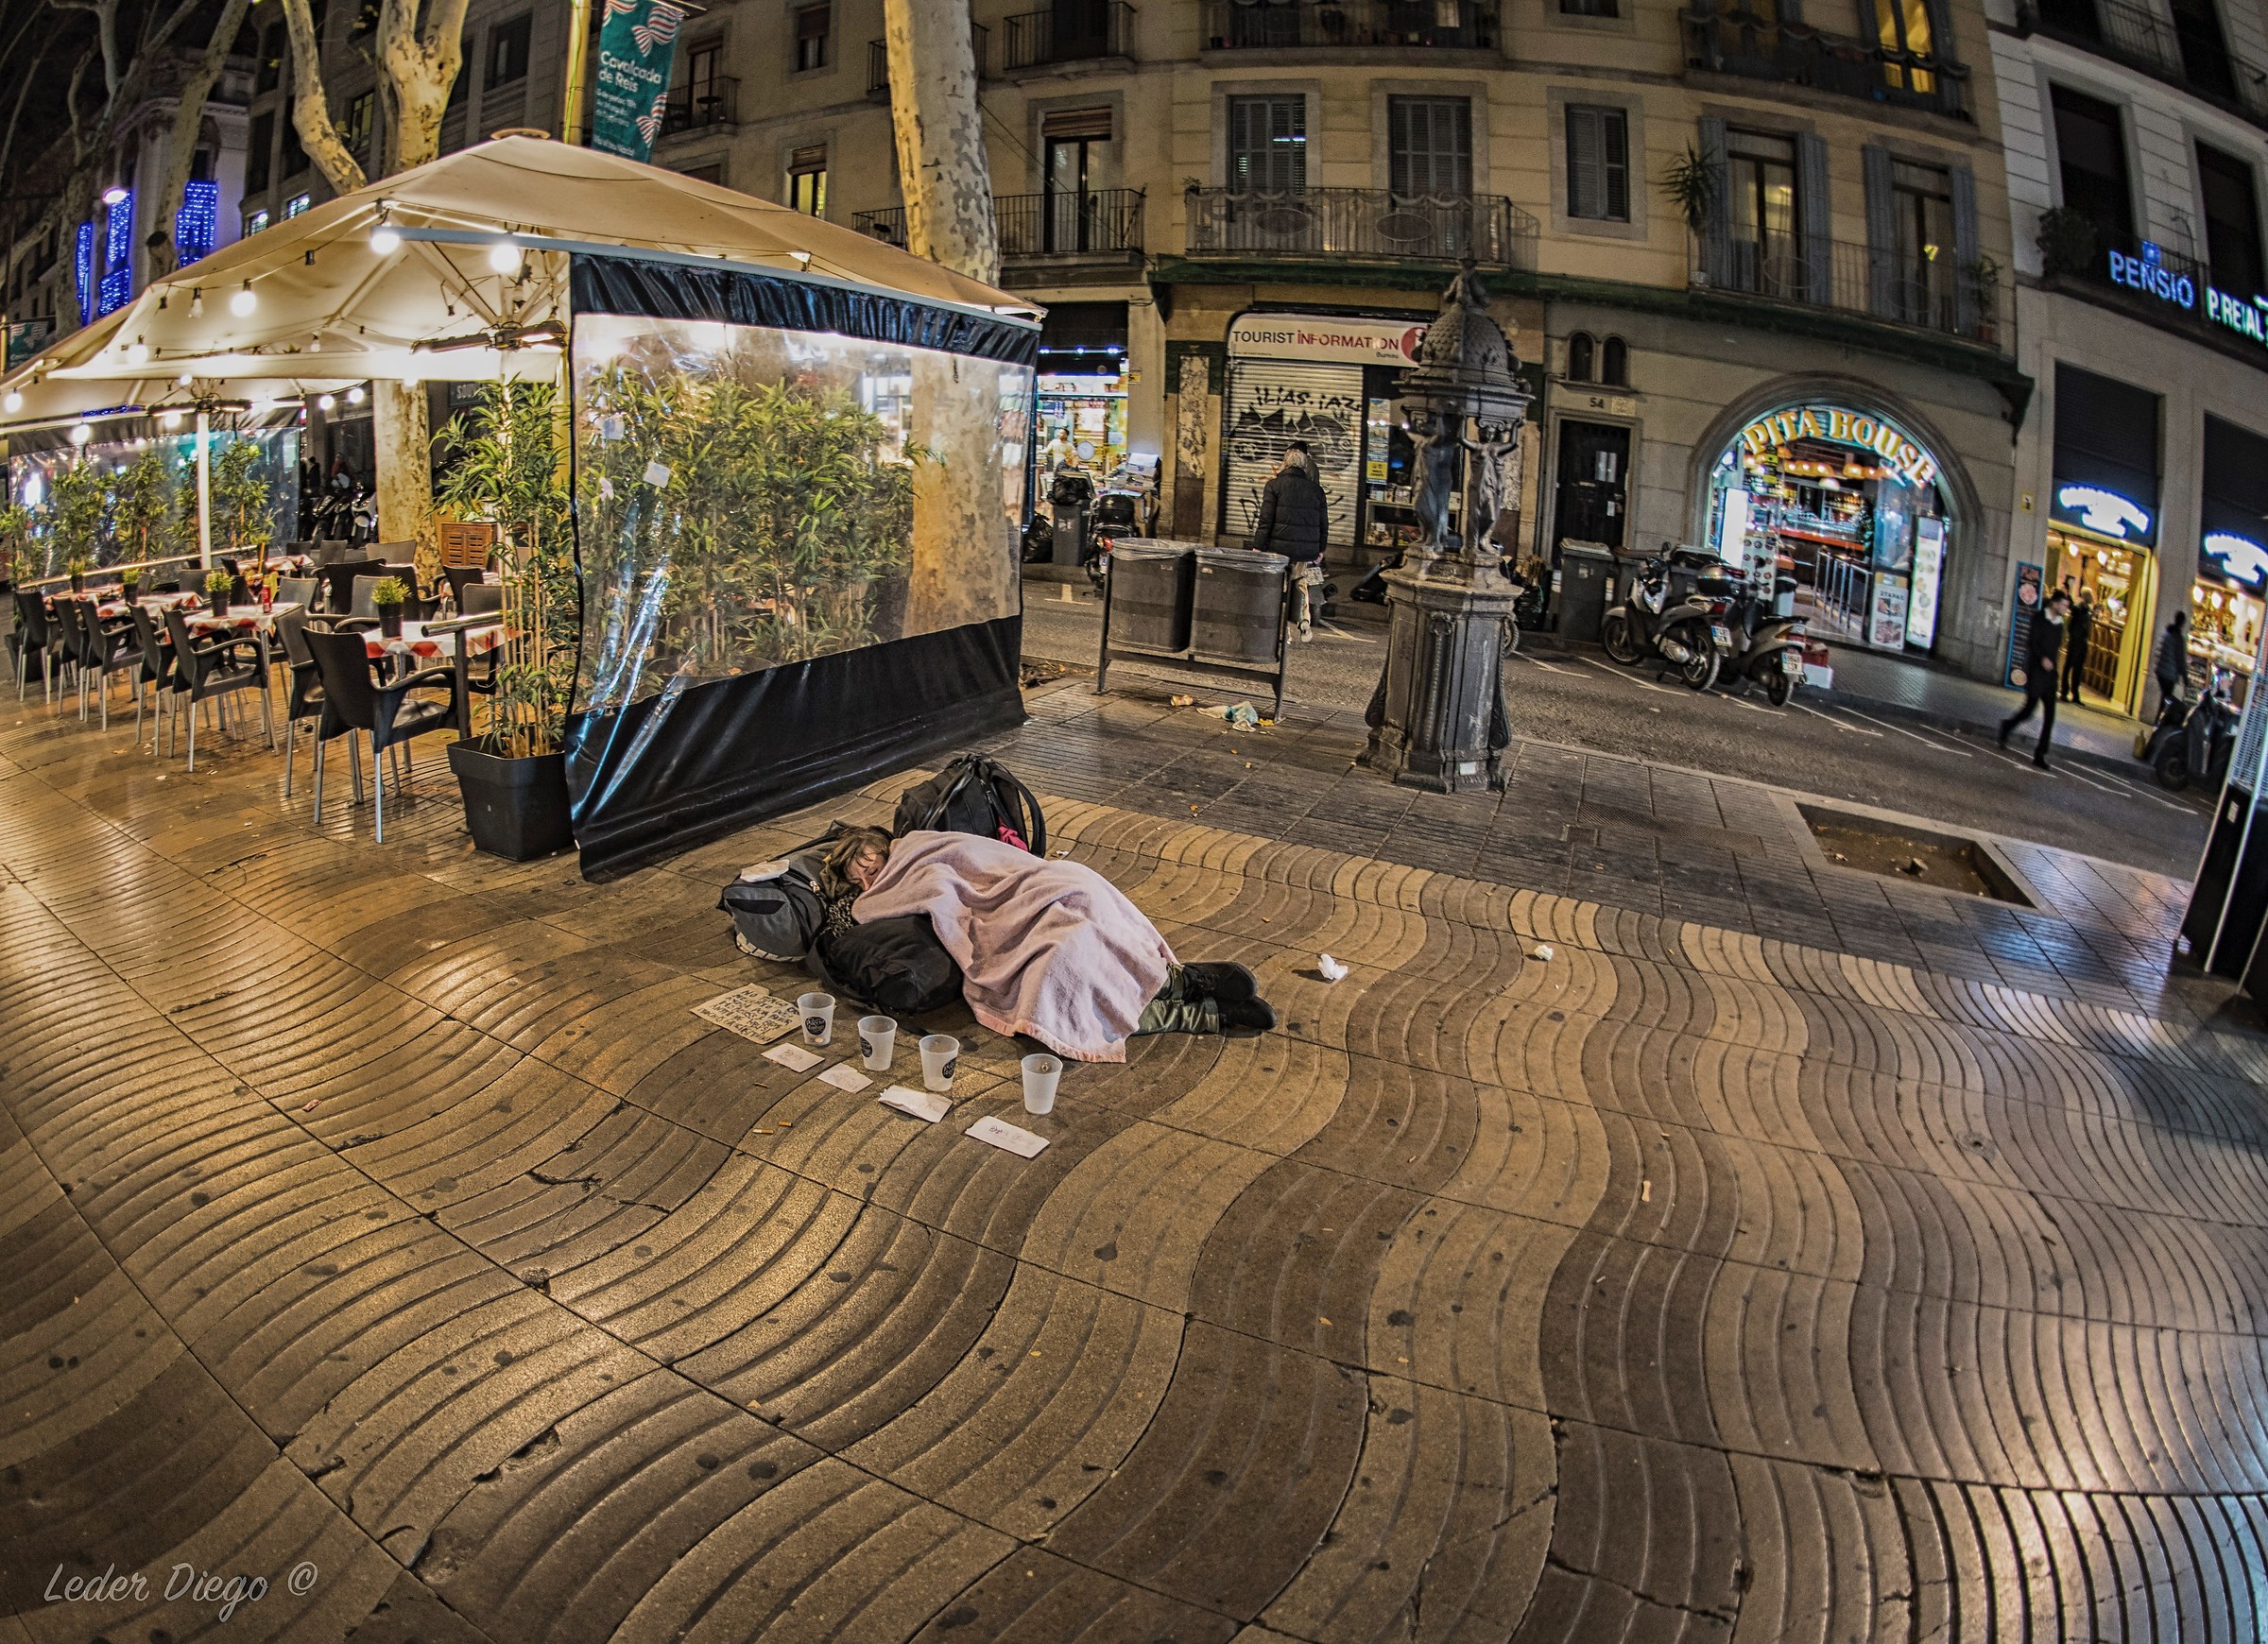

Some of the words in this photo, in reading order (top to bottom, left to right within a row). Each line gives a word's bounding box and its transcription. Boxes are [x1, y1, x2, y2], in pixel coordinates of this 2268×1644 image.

[600, 50, 662, 84] Cavalcada
[598, 68, 613, 83] de
[615, 72, 639, 93] Reis
[1233, 330, 1295, 344] TOURIST
[1589, 397, 1605, 408] 54
[1743, 409, 1823, 455] PITA
[1828, 410, 1937, 489] HOUSE
